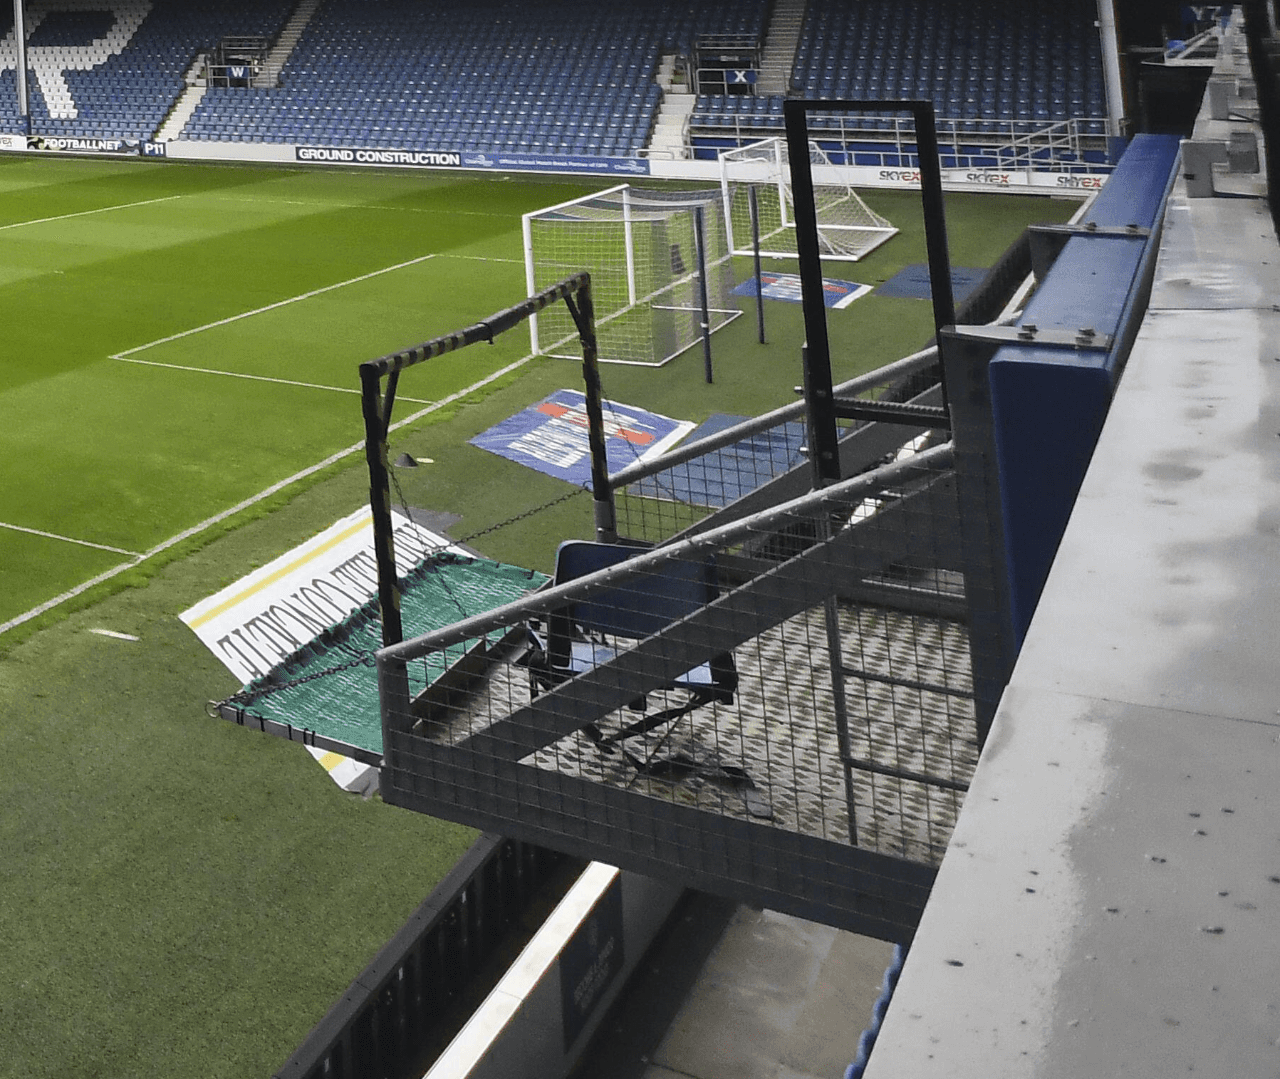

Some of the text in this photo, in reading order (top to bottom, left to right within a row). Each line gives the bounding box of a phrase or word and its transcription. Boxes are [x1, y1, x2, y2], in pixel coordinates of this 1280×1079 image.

[231, 65, 244, 78] W
[734, 70, 747, 82] X
[43, 137, 121, 151] FOOTBALLNET
[144, 143, 164, 155] P11
[298, 148, 353, 162] GROUND
[356, 149, 461, 166] CONSTRUCTION
